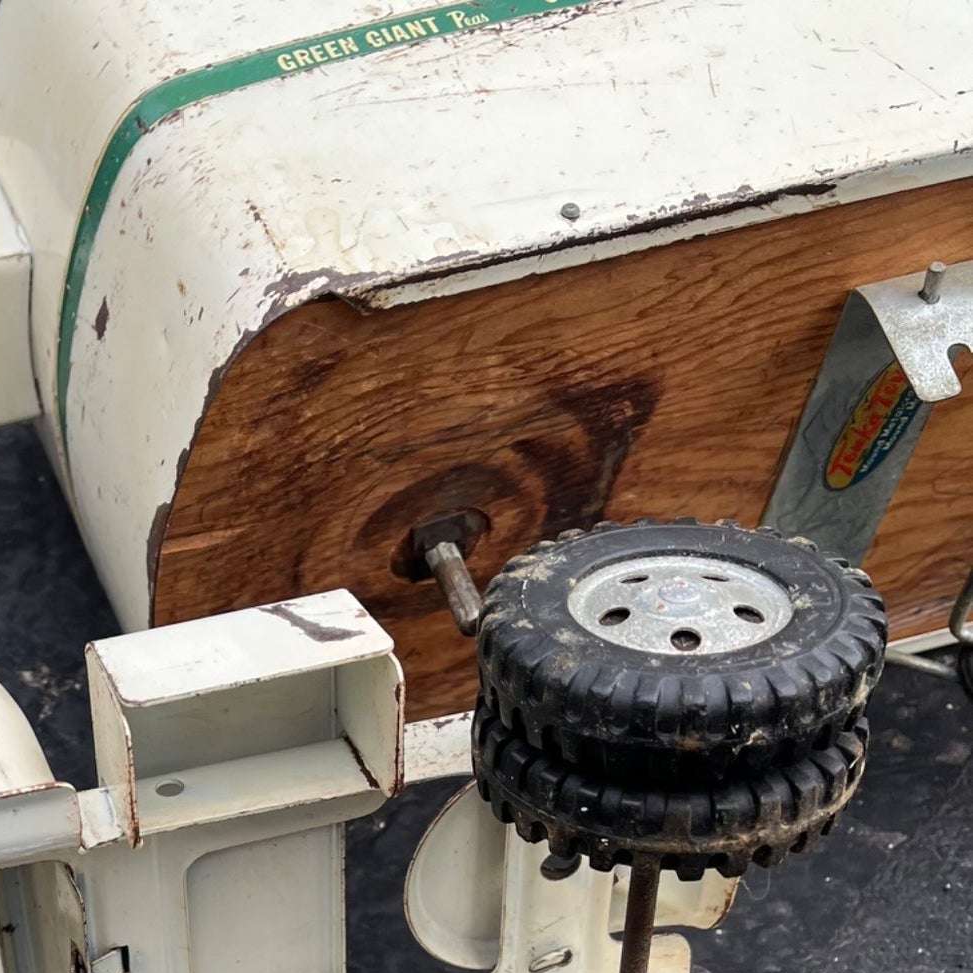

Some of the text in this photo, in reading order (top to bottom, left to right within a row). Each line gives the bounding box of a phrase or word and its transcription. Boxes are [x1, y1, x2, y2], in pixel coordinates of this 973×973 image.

[277, 10, 490, 71] GREEN GIANT Peas
[865, 368, 909, 410] Toy
